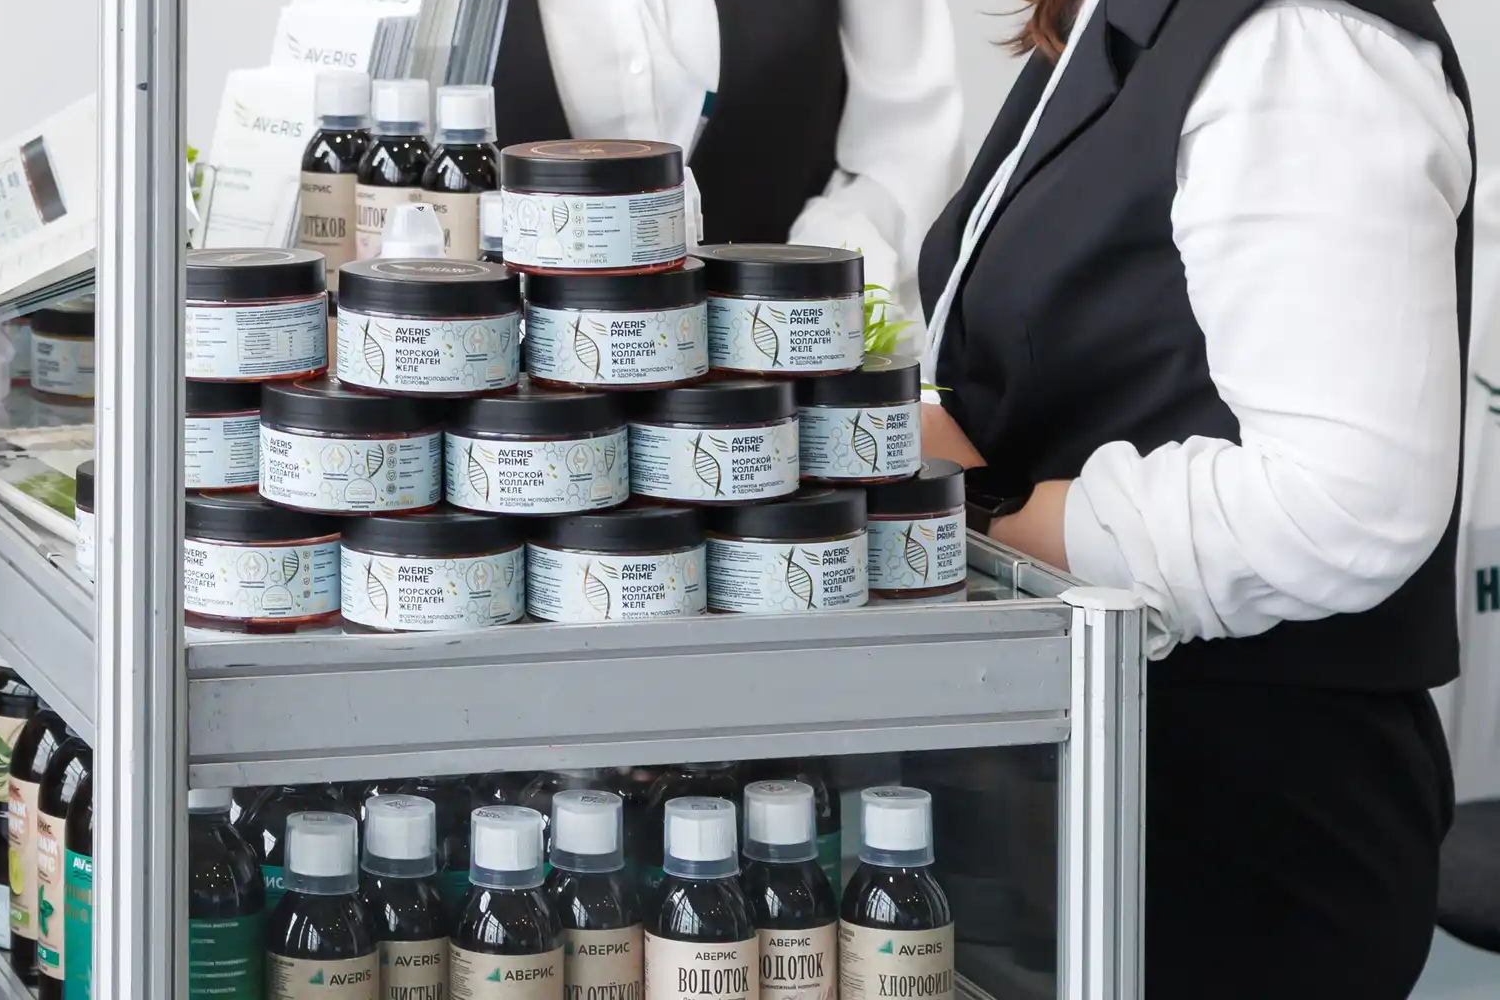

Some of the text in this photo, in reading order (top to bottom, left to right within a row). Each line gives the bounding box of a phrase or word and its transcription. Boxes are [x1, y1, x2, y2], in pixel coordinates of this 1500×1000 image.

[304, 47, 358, 68] AVERIS
[252, 116, 304, 138] AVERIS
[789, 308, 823, 317] AVERIS
[610, 320, 646, 329] AVERIS
[789, 317, 820, 325] PRIME
[395, 327, 431, 337] AVERIS
[610, 329, 642, 337] PRIME
[790, 328, 831, 337] МОРСКОЙ
[395, 336, 426, 345] PRIME
[611, 340, 655, 349] МОРСКОЙ
[790, 337, 832, 345] КОЛЛАГЕН
[395, 349, 440, 357] МОРСКОЙ
[611, 349, 656, 357] КОЛЛАГЕН
[790, 345, 813, 353] ЖЕЛЕ
[395, 357, 441, 365] КОЛЛАГЕН
[611, 357, 636, 365] ЖЕЛЕ
[395, 364, 419, 372] ЖЕЛЕ
[886, 421, 908, 430] PRIME
[270, 437, 292, 450] AVERIS
[731, 435, 765, 445] AVERIS
[270, 445, 289, 457] PRIME
[731, 444, 760, 453] PRIME
[498, 450, 533, 458] AVERIS
[498, 458, 529, 467] PRIME
[732, 454, 771, 466] МОРСКОЙ
[732, 464, 772, 474] КОЛЛАГЕН
[499, 470, 543, 479] МОРСКОЙ
[732, 473, 755, 481] ЖЕЛЕ
[822, 547, 850, 558] AVERIS
[822, 556, 847, 566] PRIME
[398, 566, 434, 575] AVERIS
[622, 563, 657, 572] AVERIS
[823, 566, 855, 578] МОРСКОЙ
[398, 574, 429, 583] PRIME
[622, 572, 653, 580] PRIME
[398, 587, 443, 596] МОРСКОЙ
[622, 583, 665, 593] МОРСКОЙ
[823, 585, 842, 594] ЖЕЛЕ
[399, 595, 444, 603] КОЛЛАГЕН
[622, 593, 665, 601] КОЛЛАГЕН
[399, 603, 423, 611] ЖЕЛЕ
[622, 601, 646, 609] ЖЕЛЕ
[769, 937, 811, 947] АВЕРИС
[578, 942, 630, 956] АВЕРИС
[899, 942, 942, 956] AVERIS
[394, 953, 441, 967] AVERIS
[695, 951, 737, 961] АВЕРИС
[329, 969, 372, 986] AVERIS
[504, 965, 554, 982] АВЕРИС
[678, 966, 749, 996] ВОДОТОК
